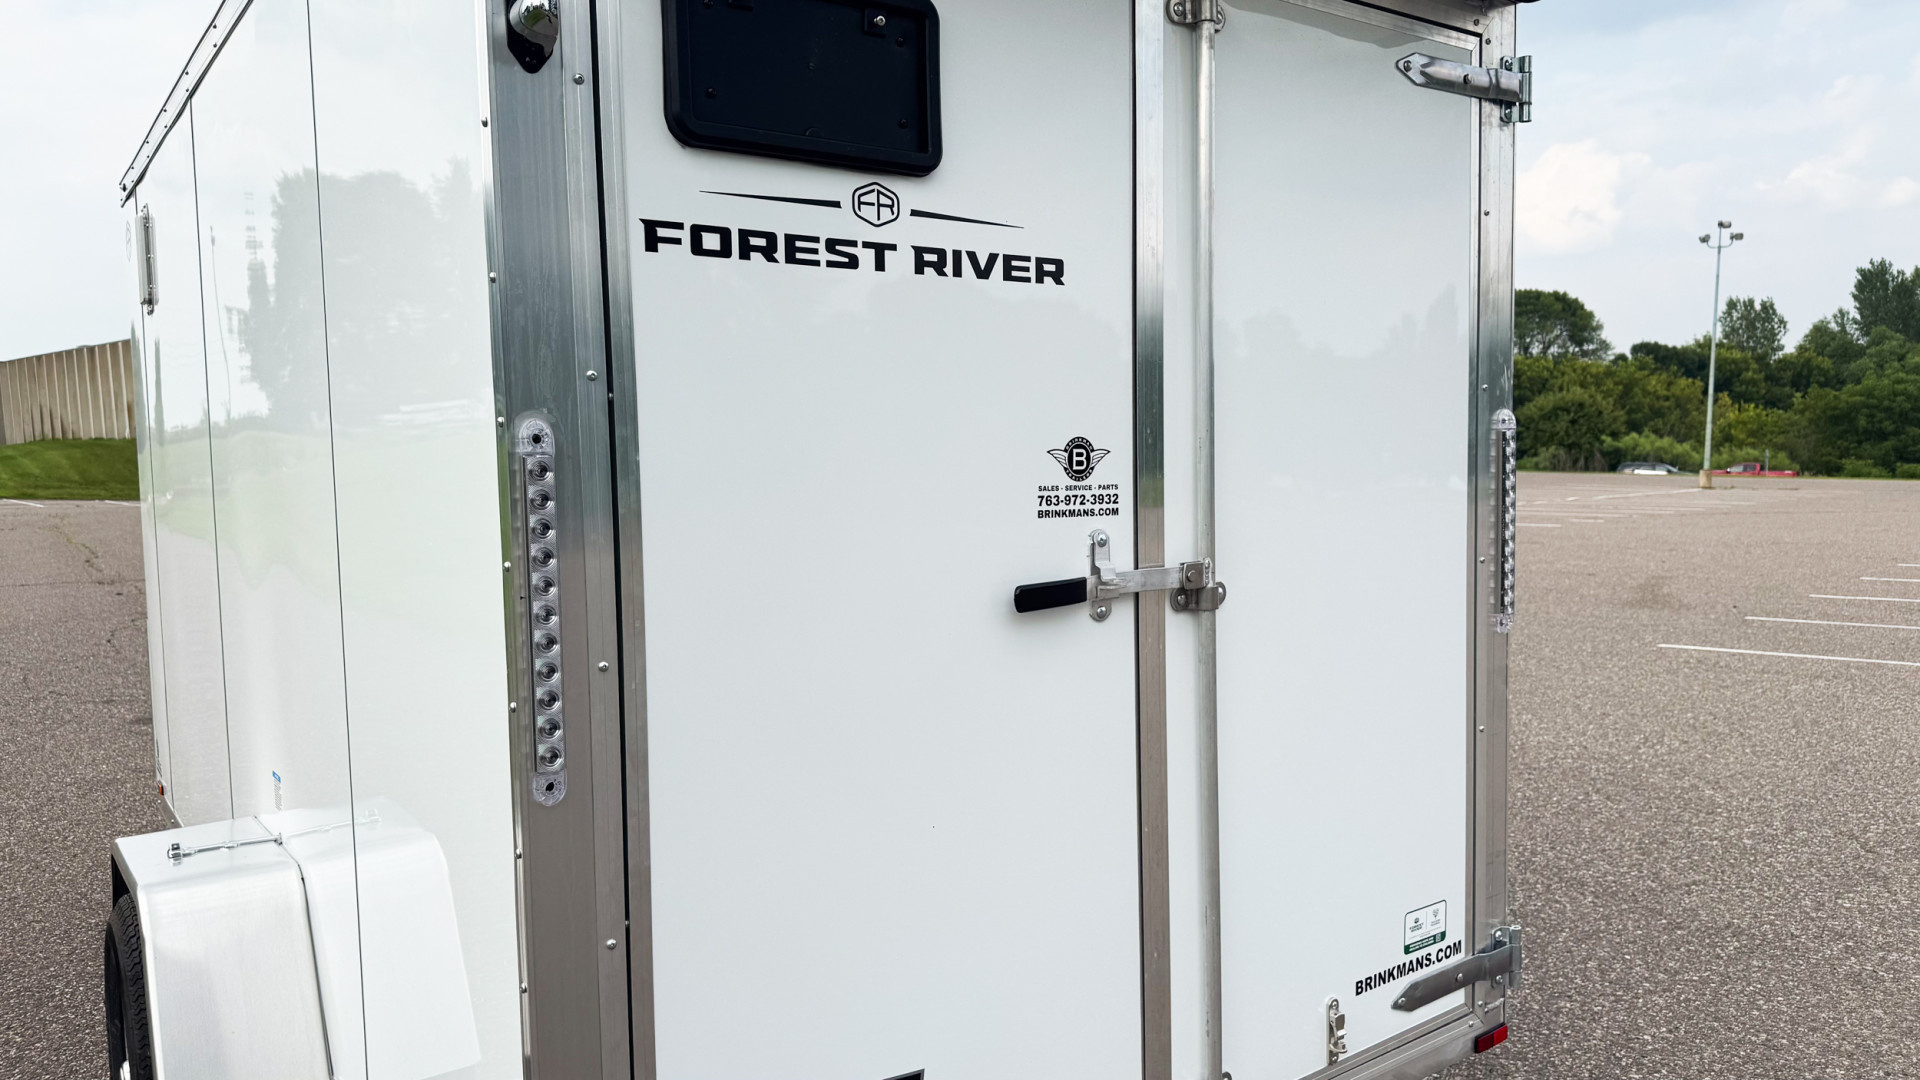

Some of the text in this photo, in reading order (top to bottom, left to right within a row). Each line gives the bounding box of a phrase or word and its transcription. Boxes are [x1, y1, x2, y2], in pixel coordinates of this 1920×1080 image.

[857, 187, 895, 221] FR
[638, 218, 1065, 286] FOREST RIVER
[1072, 448, 1087, 470] B
[1037, 493, 1119, 507] 763-972-3932
[1037, 507, 1119, 519] BRINKMANS.COM
[1355, 939, 1462, 996] BRINKMANS.COM
